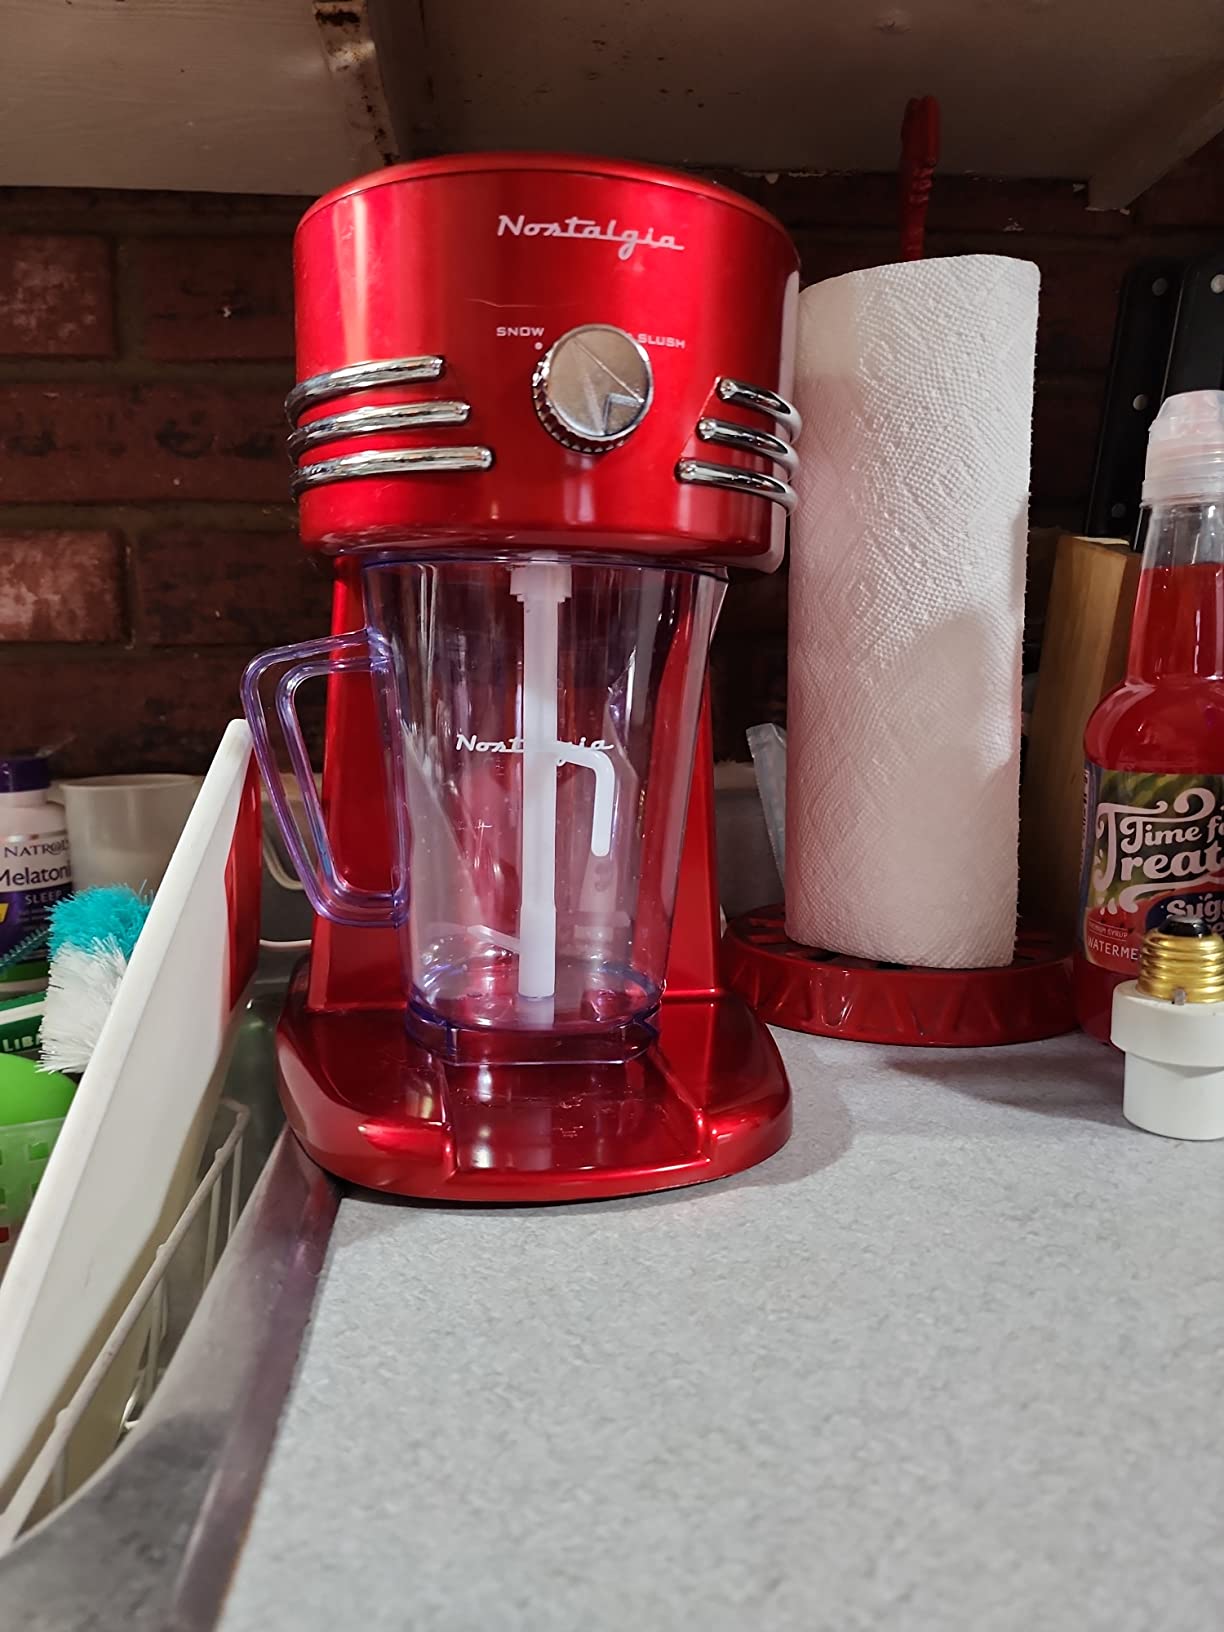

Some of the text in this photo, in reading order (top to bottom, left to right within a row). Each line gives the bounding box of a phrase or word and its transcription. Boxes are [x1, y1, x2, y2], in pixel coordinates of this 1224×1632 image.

[497, 214, 685, 260] Nostalgia
[496, 326, 545, 337] SNOW
[638, 333, 686, 349] SLUSH
[455, 734, 614, 766] Nostia
[1093, 803, 1224, 891] Treat
[1166, 899, 1224, 923] Sug
[1088, 936, 1142, 960] WATERME
